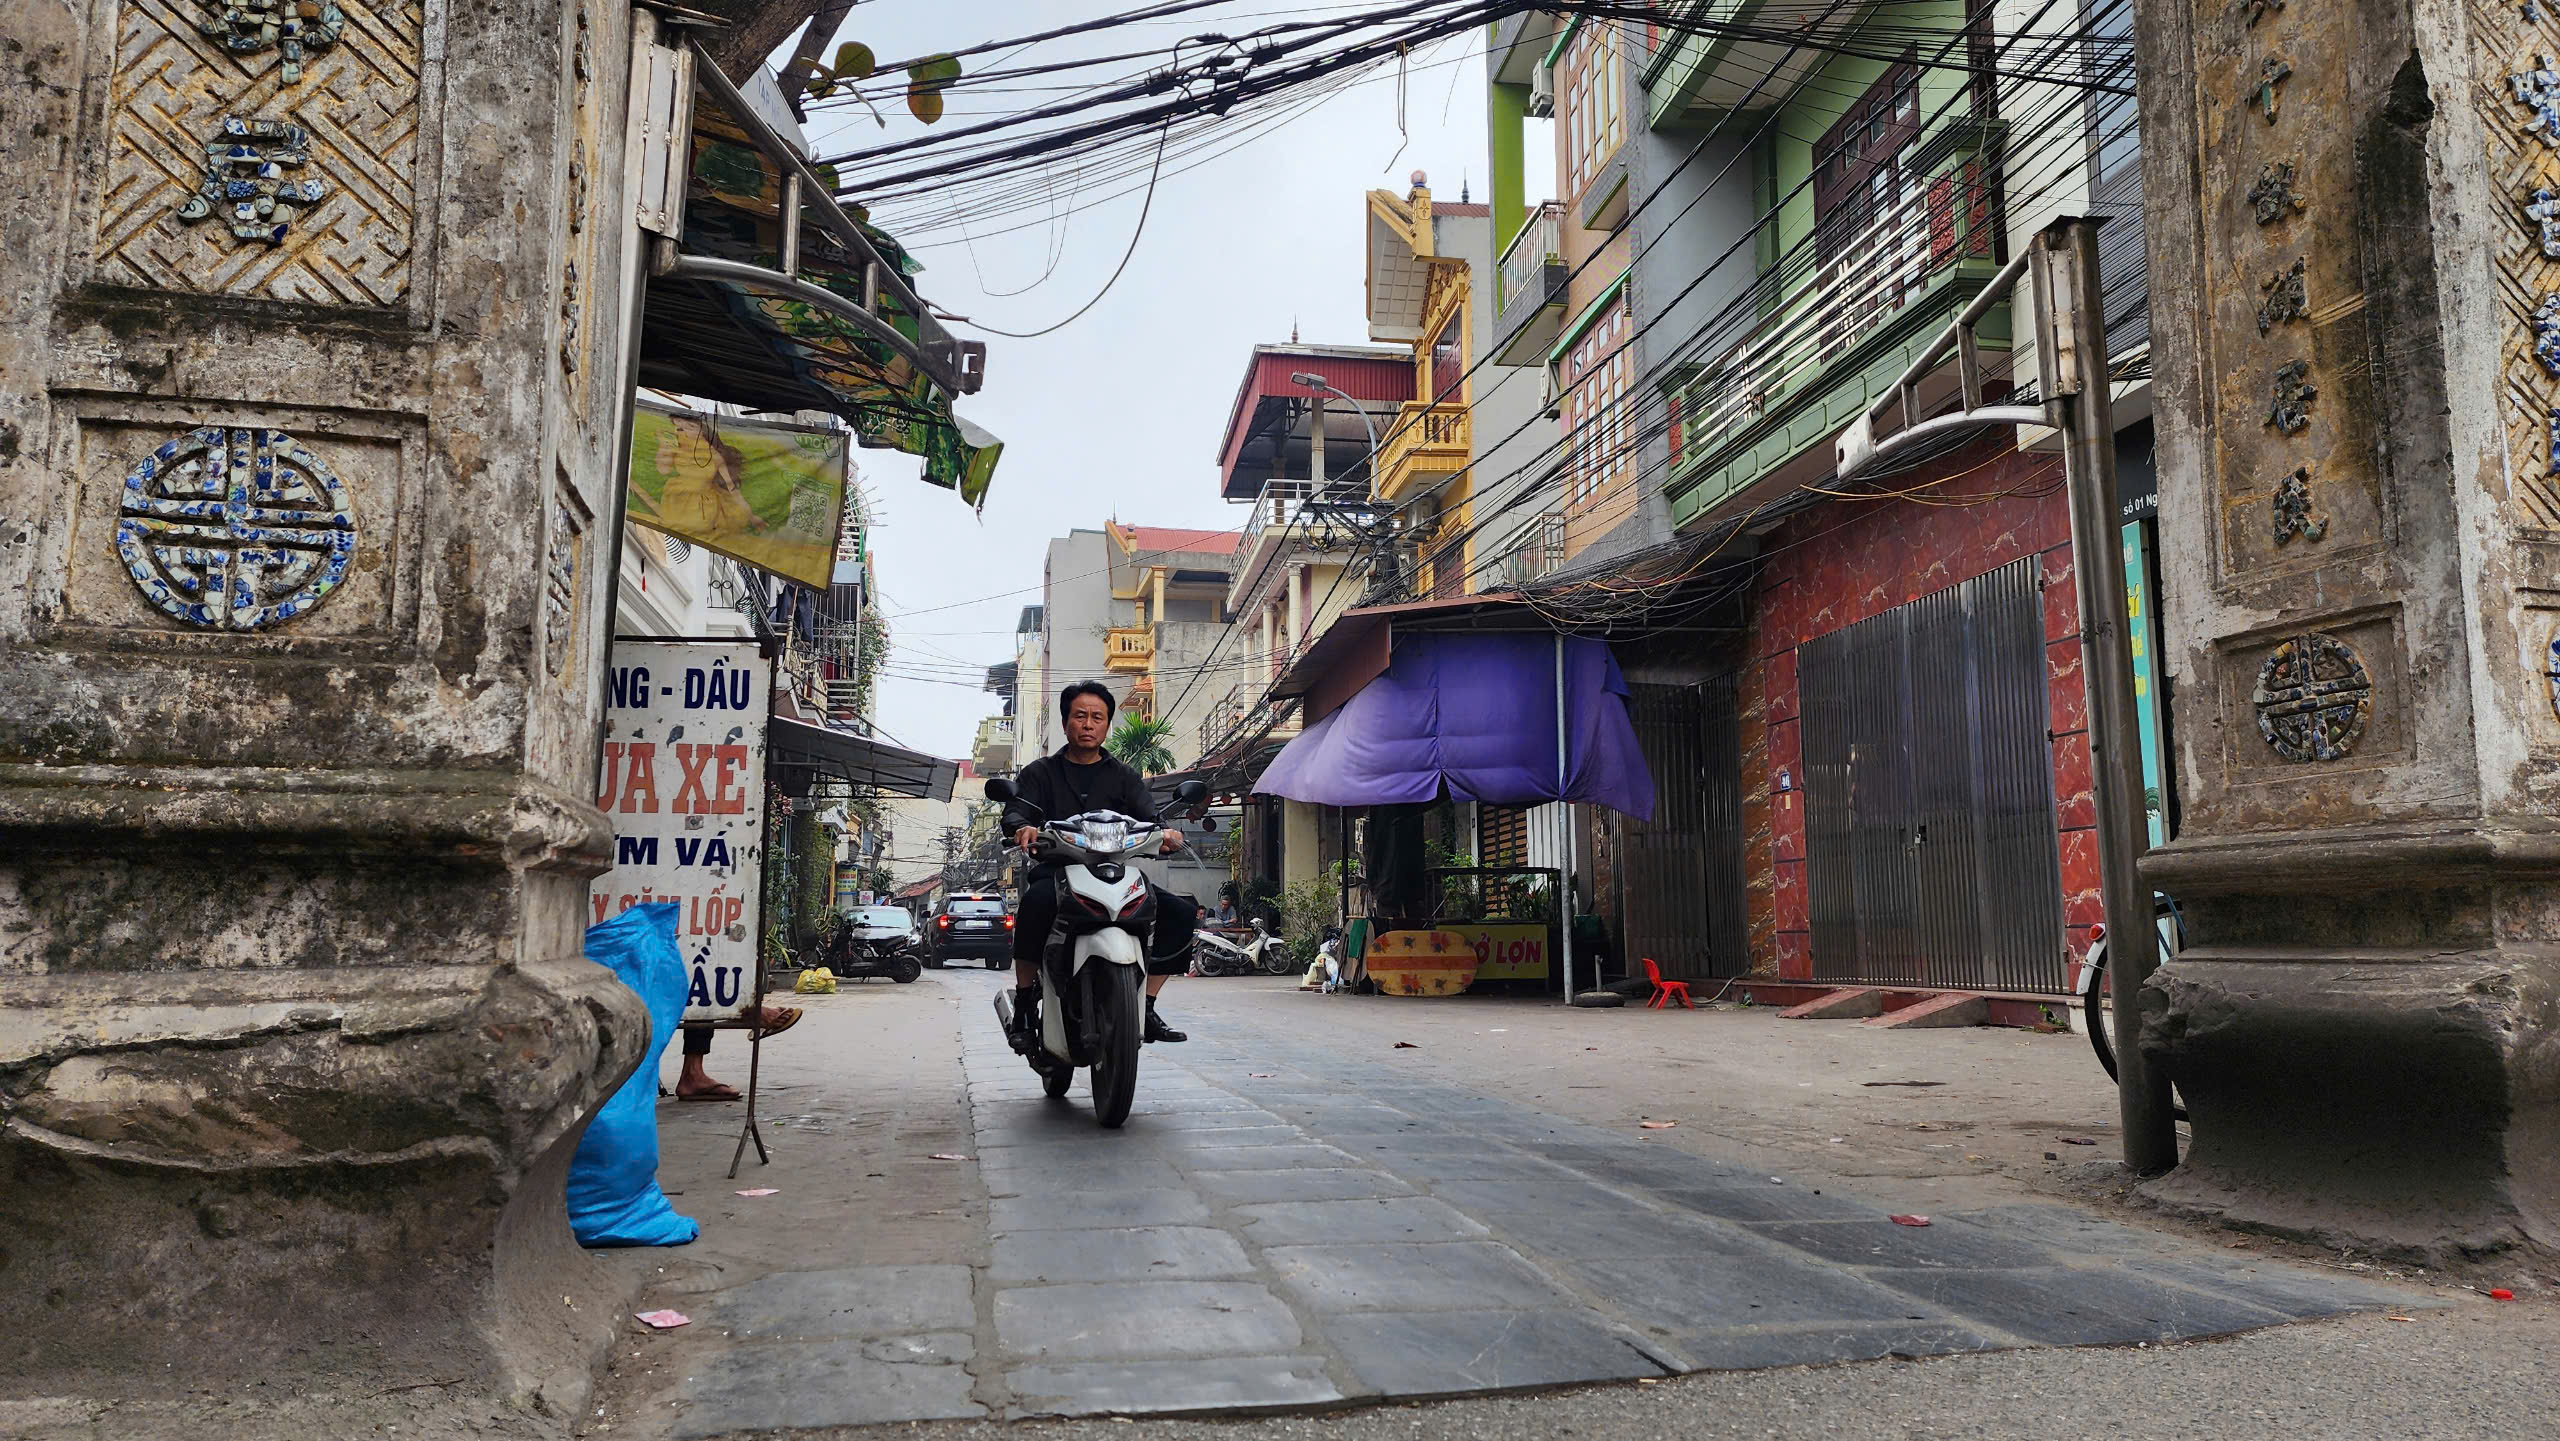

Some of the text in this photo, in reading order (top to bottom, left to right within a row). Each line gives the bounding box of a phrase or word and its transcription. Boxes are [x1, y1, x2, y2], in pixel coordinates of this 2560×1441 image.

[2123, 498, 2133, 515] số
[2135, 497, 2144, 510] 01
[684, 656, 751, 710] DẦU
[672, 744, 748, 814] XE
[614, 831, 731, 866] M VÁ
[586, 894, 610, 925] Y
[690, 884, 742, 936] LỐP
[1470, 932, 1542, 972] Ở LỢN
